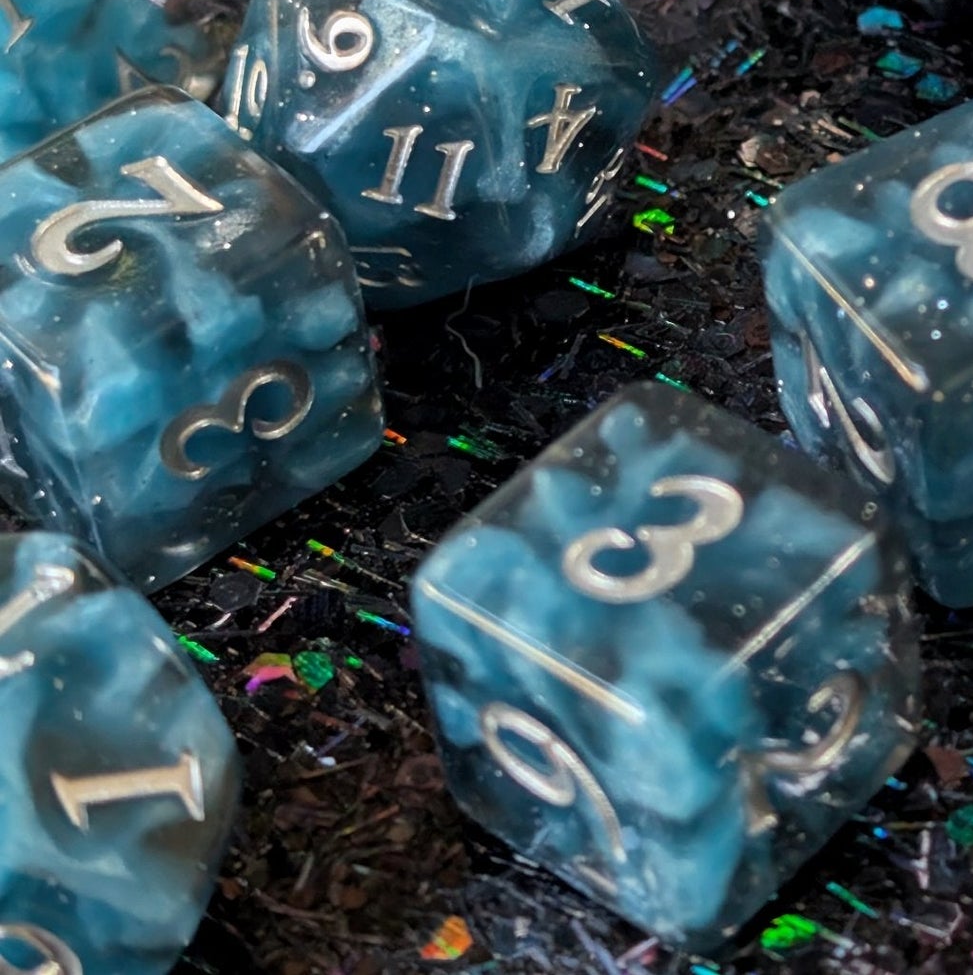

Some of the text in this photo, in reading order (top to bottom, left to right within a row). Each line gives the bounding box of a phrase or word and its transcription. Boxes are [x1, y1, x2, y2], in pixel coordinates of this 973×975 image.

[361, 124, 476, 221] 11
[527, 82, 597, 174] 4
[30, 155, 224, 277] 2
[158, 359, 315, 481] 3
[561, 473, 745, 605] 3
[49, 749, 205, 835] 1
